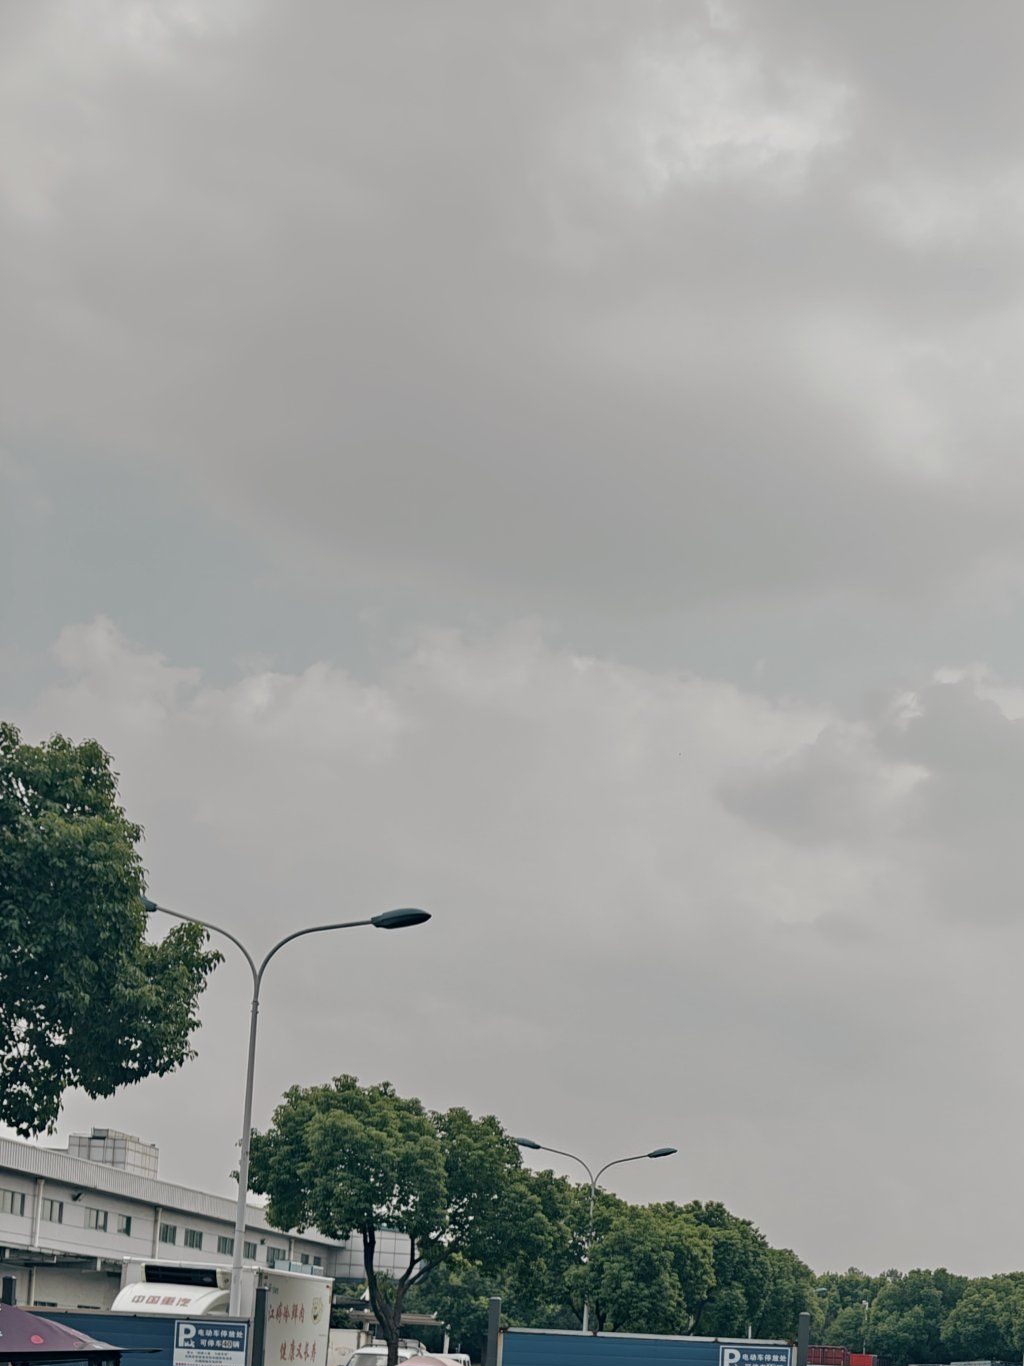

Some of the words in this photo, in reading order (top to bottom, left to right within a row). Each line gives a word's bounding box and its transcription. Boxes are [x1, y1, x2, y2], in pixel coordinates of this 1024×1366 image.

[131, 1294, 192, 1307] 中国重汽
[178, 1324, 196, 1348] P
[198, 1329, 243, 1339] 电动车停放处
[742, 1353, 787, 1362] 电动车停放处
